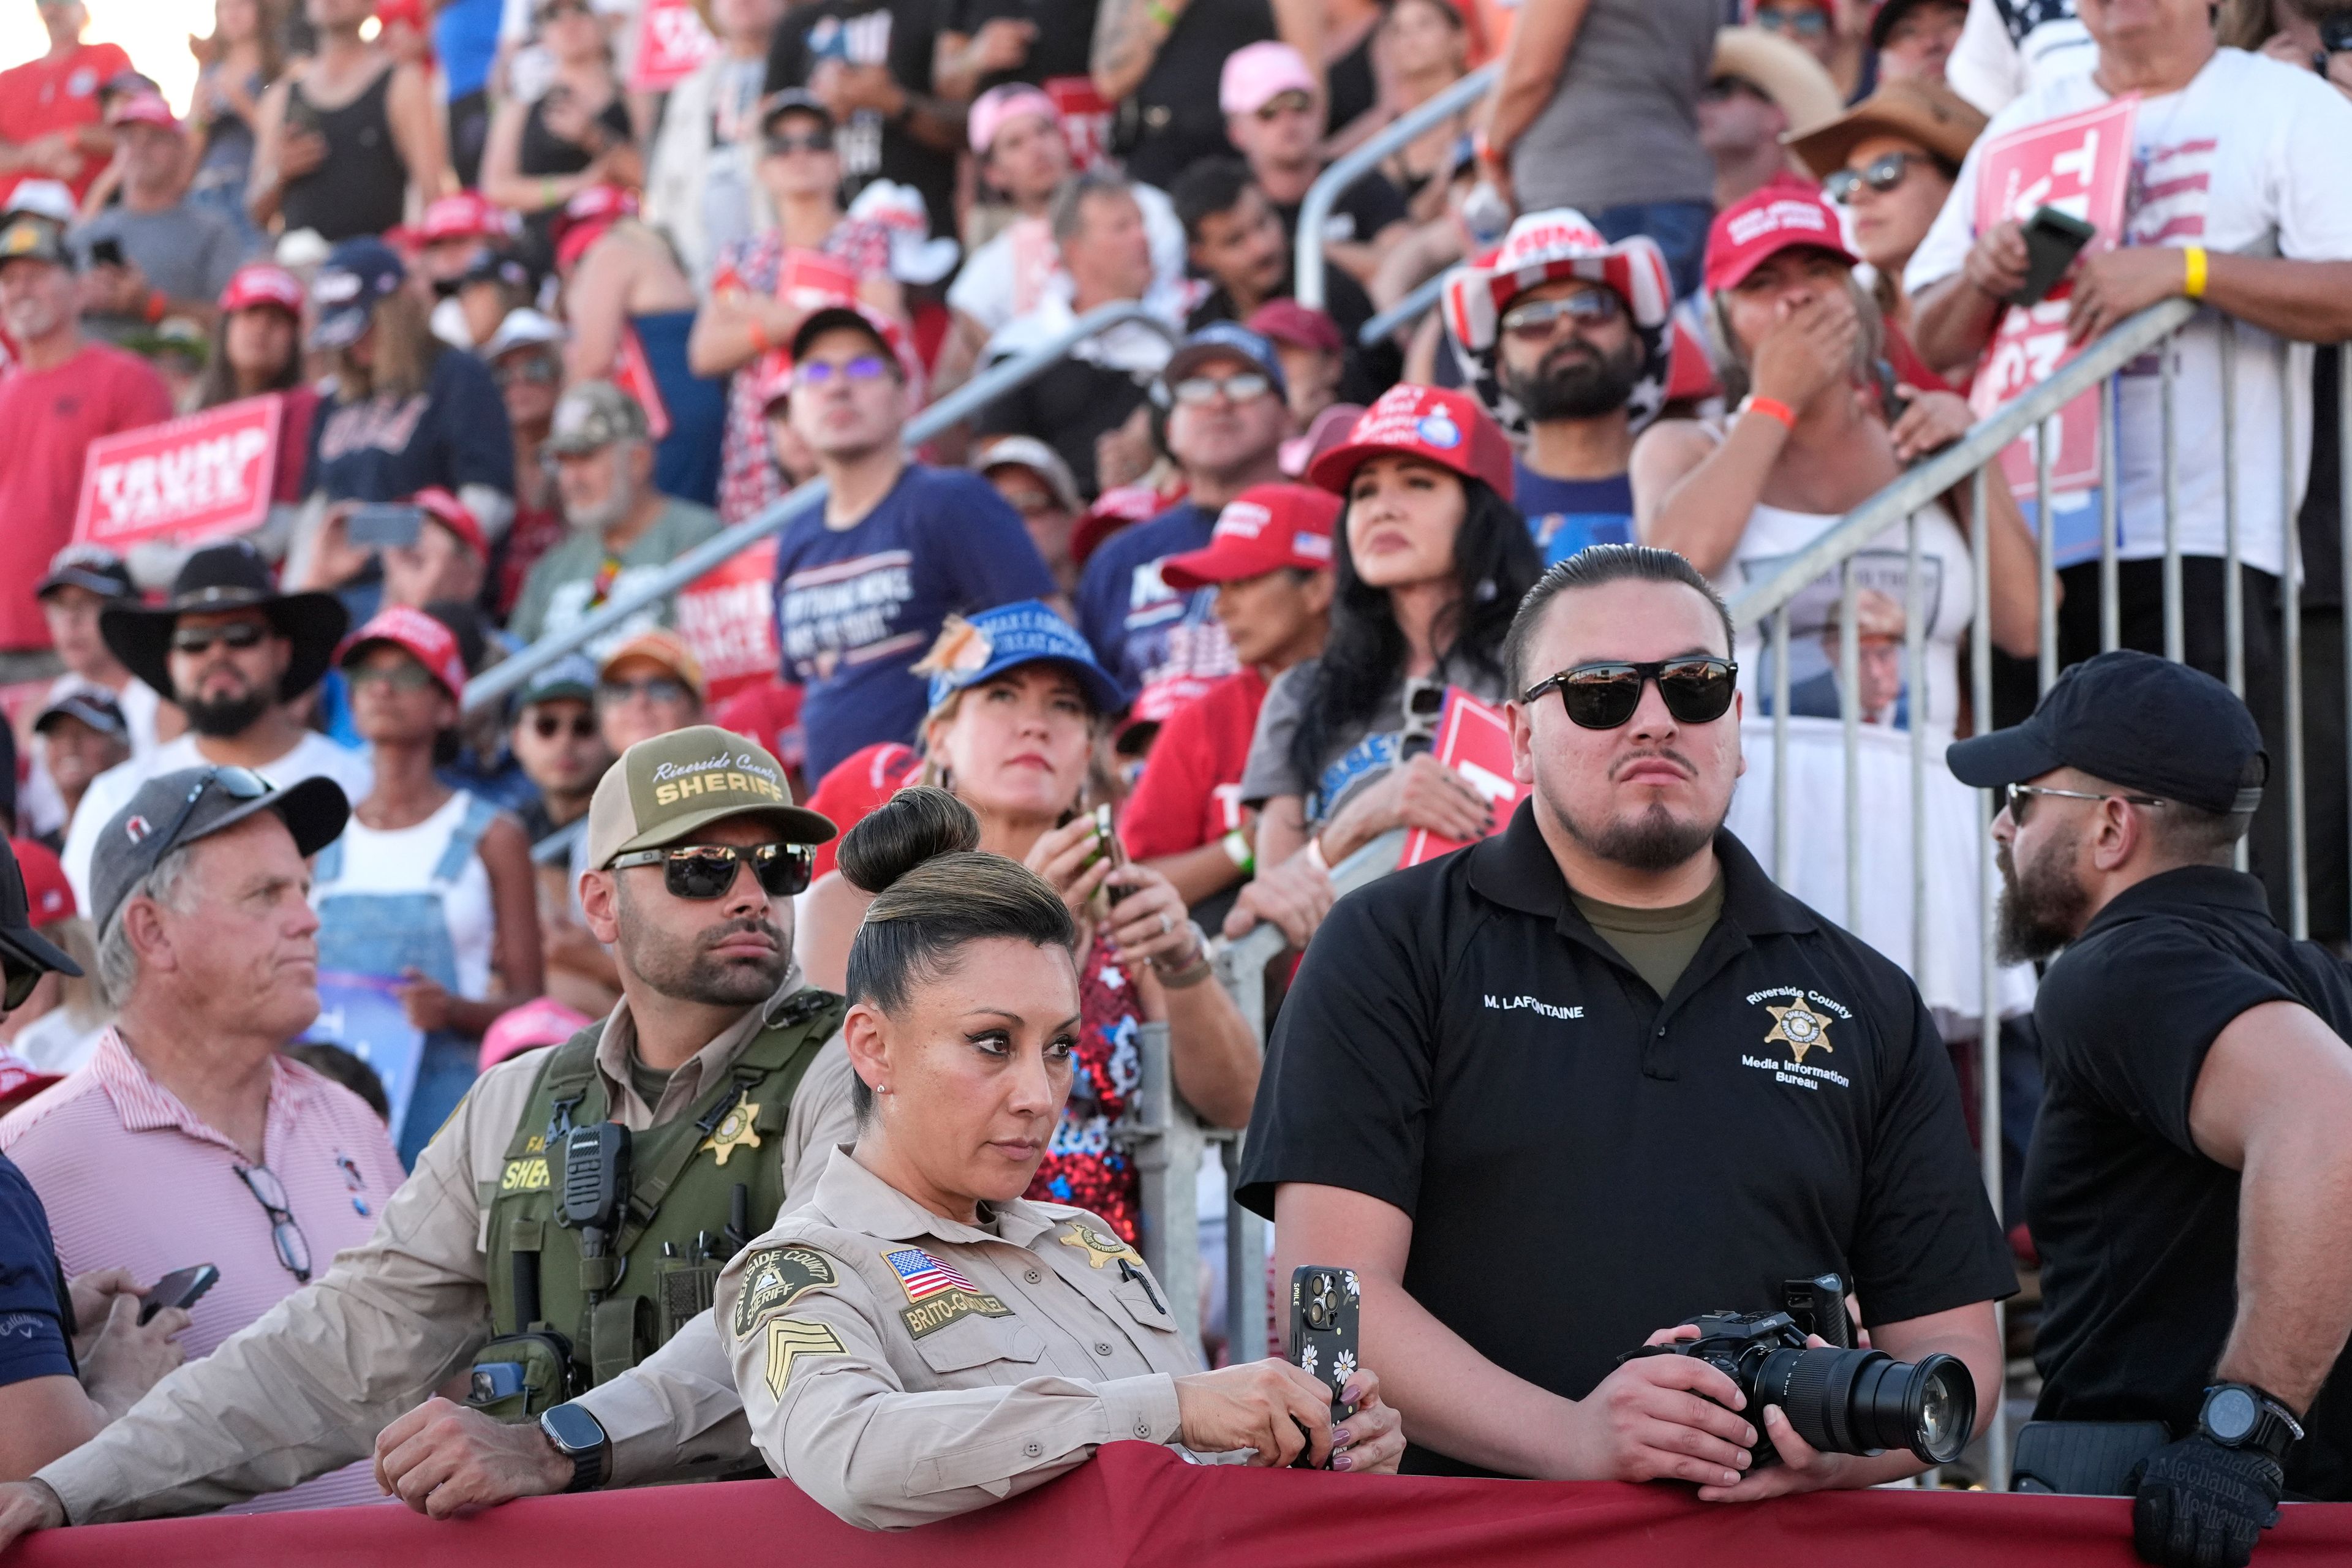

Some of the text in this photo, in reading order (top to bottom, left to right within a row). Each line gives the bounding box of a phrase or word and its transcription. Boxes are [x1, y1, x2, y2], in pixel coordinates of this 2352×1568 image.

[97, 428, 267, 504] TRUMP
[652, 752, 777, 785] Riverside County
[655, 772, 783, 805] SHERIFF
[1484, 995, 1584, 1020] M. LAFONTAINE
[1746, 986, 1852, 1019] Riverside County
[1784, 1010, 1817, 1024] SHERIFF
[1742, 1055, 1850, 1087] Media Information
[1776, 1071, 1818, 1090] Bureau
[736, 1250, 828, 1330] RIVERSIDE COUNTY
[747, 1282, 794, 1326] SHERIFF
